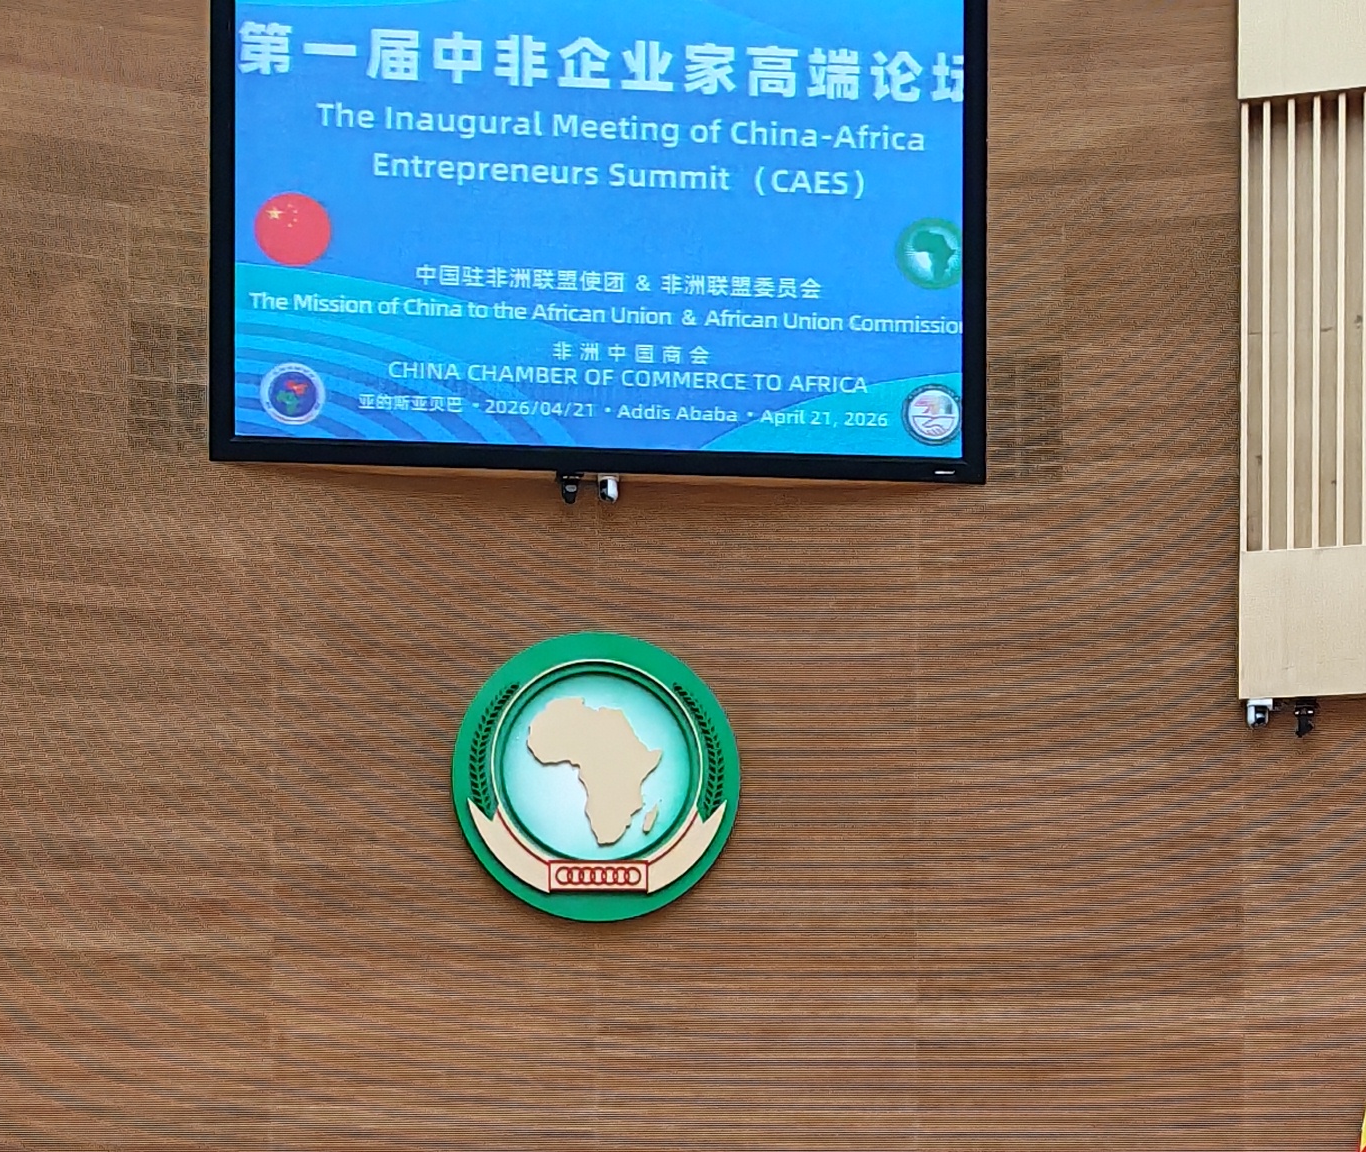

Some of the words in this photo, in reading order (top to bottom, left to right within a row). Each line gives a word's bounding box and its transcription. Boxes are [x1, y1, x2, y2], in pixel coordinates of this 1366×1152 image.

[316, 101, 374, 129] The
[386, 106, 542, 139] Inaugural
[553, 113, 679, 148] Meeting
[690, 119, 722, 145] of
[731, 120, 925, 152] China-Africa
[373, 153, 598, 186] Entrepreneurs
[609, 163, 730, 191] Summit
[415, 264, 624, 293] 中国驻非洲联盟使团
[636, 274, 651, 292] &
[661, 273, 822, 300] 非洲联盟委员会
[249, 291, 288, 311] The
[294, 293, 374, 314] Mission
[379, 295, 399, 315] of
[404, 297, 462, 318] China
[468, 299, 485, 319] to
[494, 299, 526, 320] the
[533, 303, 605, 323] African
[611, 306, 672, 325] Union
[681, 308, 696, 326] &
[704, 309, 777, 330] African
[785, 312, 843, 332] Union
[389, 361, 461, 381] CHINA
[468, 364, 578, 386] CHAMBER
[585, 368, 614, 386] OF
[621, 370, 747, 391] COMMERCE
[754, 374, 782, 392] TO
[789, 375, 868, 395] AFRICA
[485, 400, 594, 418] 2026/04/21
[617, 404, 670, 421] Addis
[676, 405, 737, 422] Ababa
[760, 409, 805, 428] April
[811, 410, 838, 428] 21,
[844, 411, 888, 428] 2026
